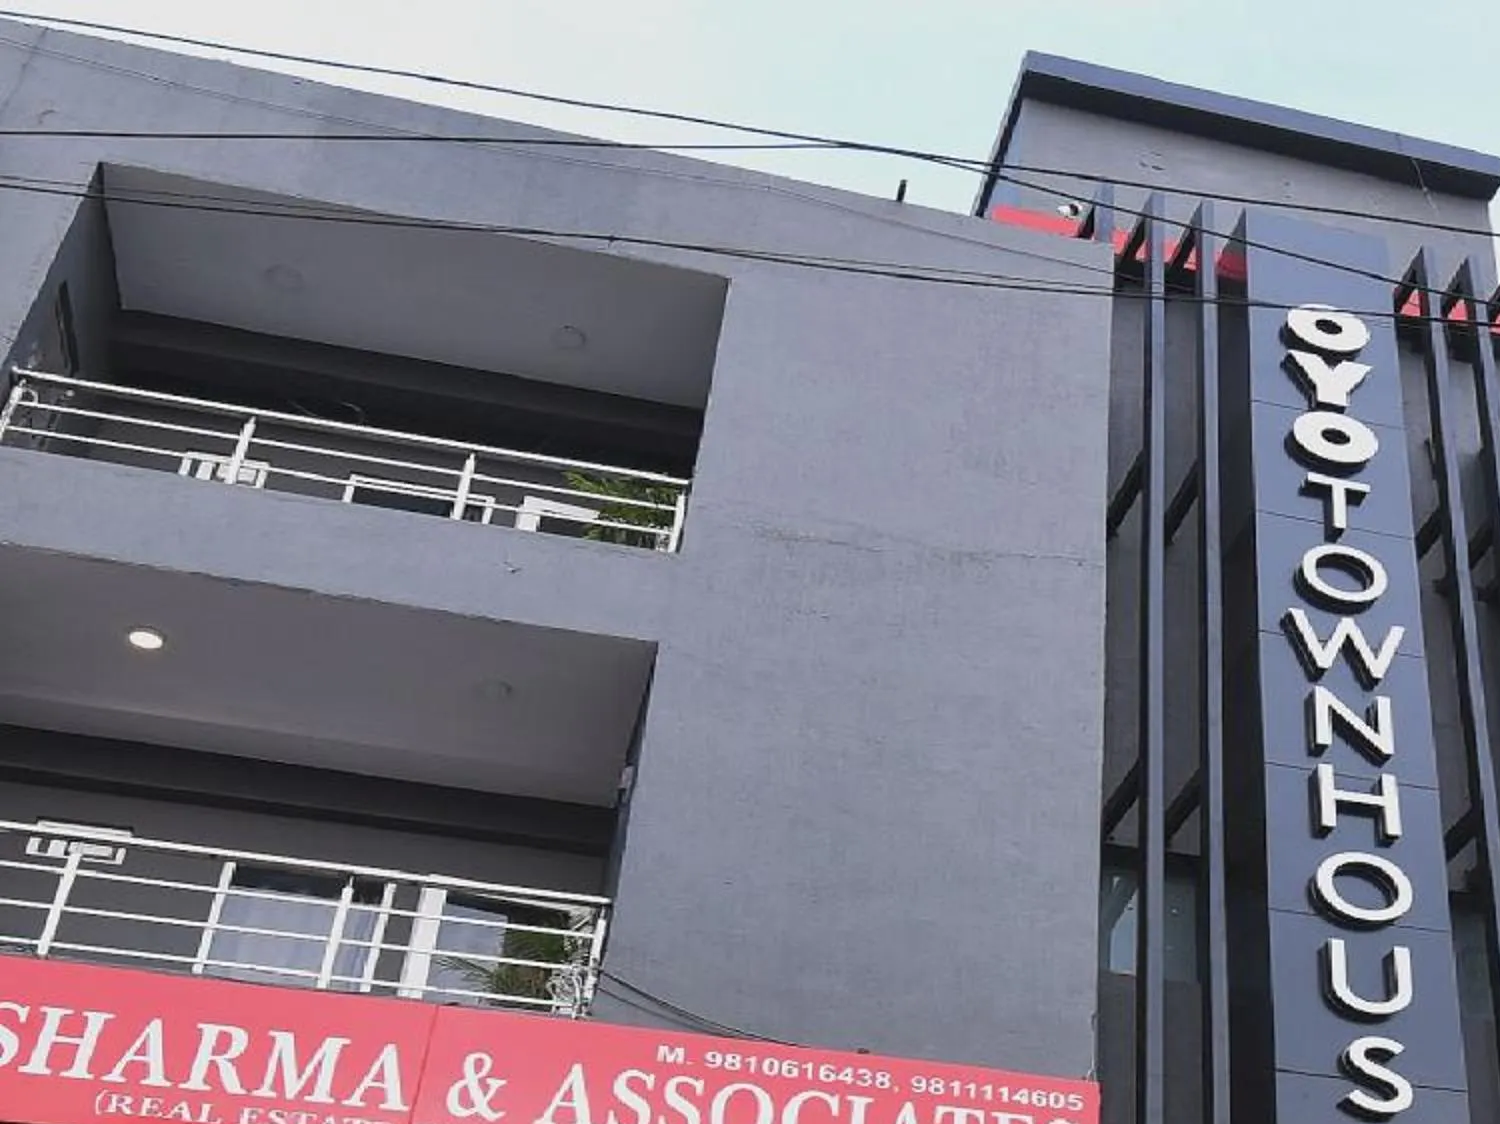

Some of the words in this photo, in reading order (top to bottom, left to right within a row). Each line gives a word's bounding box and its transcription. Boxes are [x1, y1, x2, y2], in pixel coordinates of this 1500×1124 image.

[1286, 303, 1379, 464] OYO
[0, 1001, 409, 1112] SHARMA
[445, 1051, 507, 1123] &
[910, 1075, 1085, 1112] 9811114605
